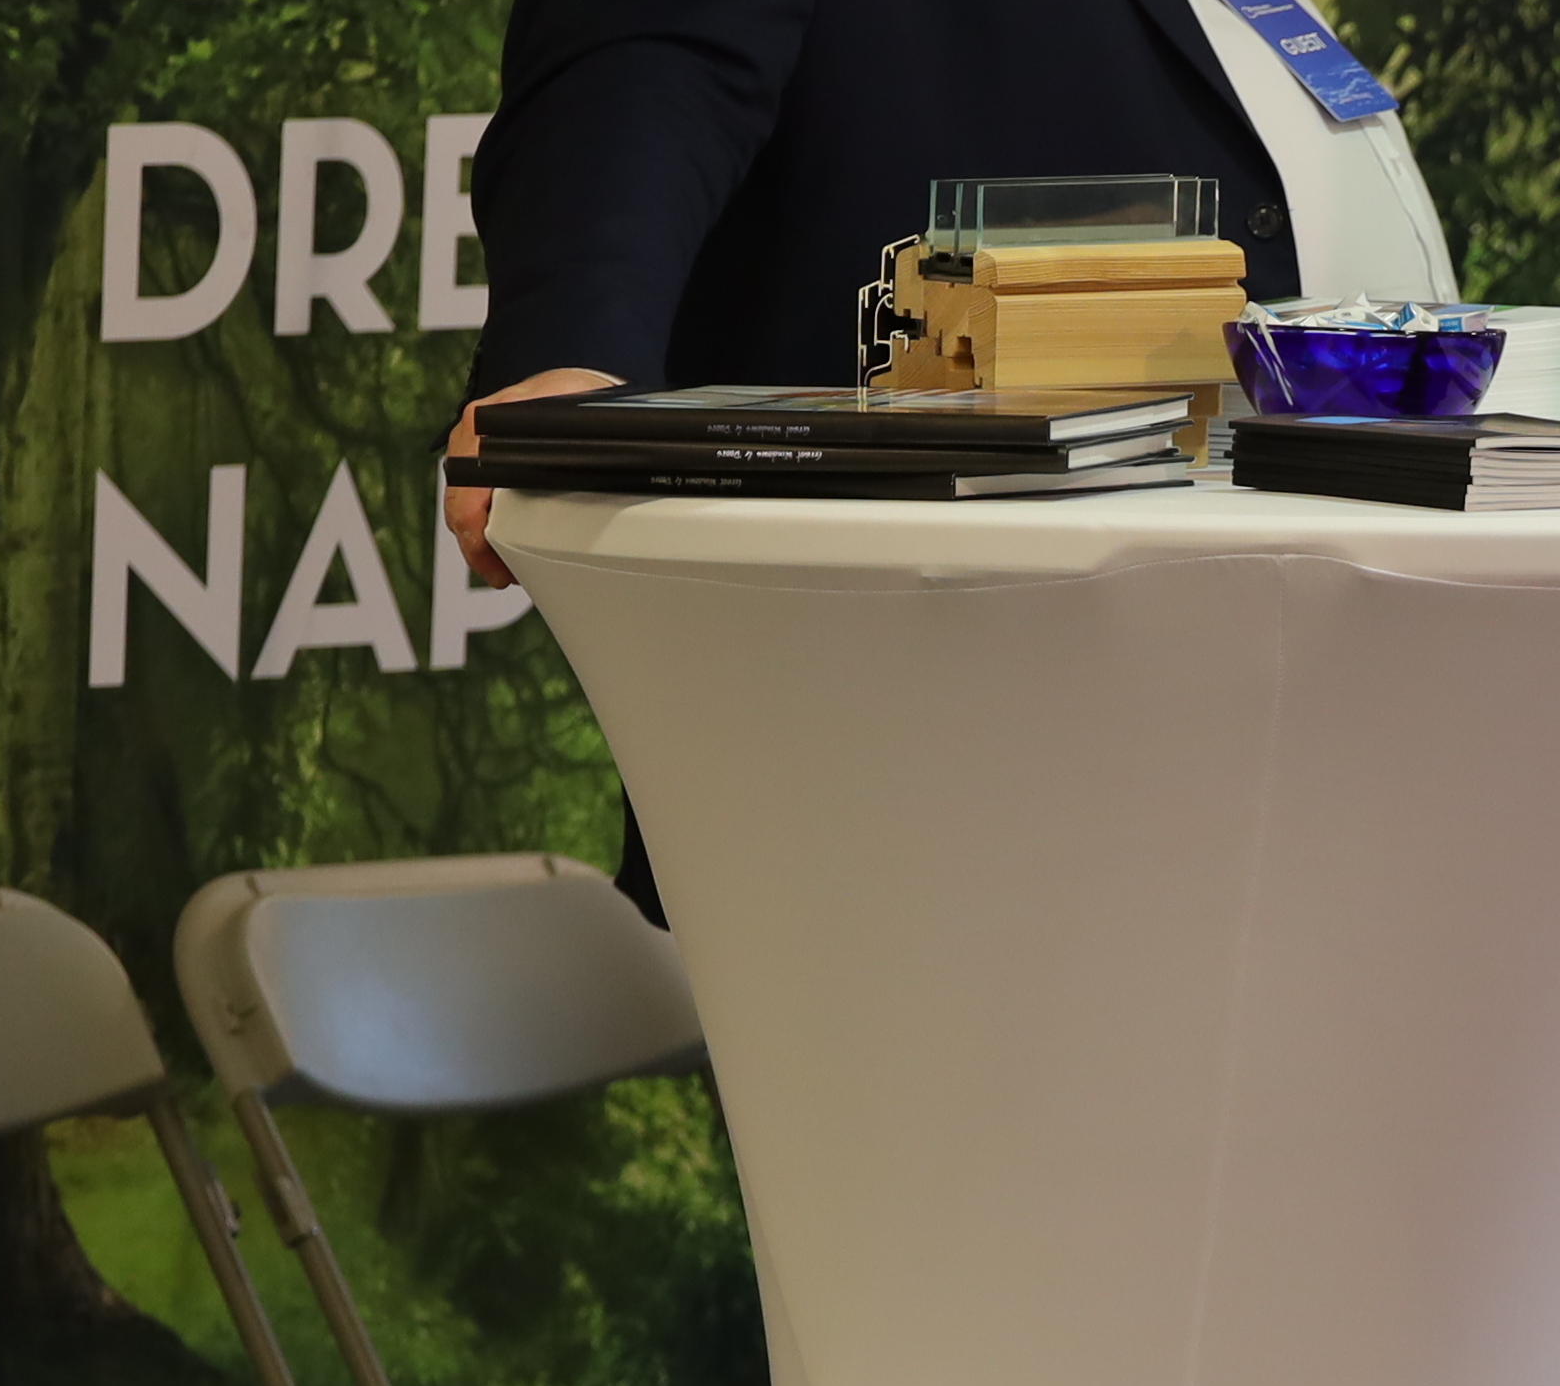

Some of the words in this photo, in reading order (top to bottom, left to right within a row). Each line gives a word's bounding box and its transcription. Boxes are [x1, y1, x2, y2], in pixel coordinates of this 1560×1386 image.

[1280, 32, 1327, 56] GUEST
[716, 450, 742, 459] Doors
[756, 451, 793, 463] Windows
